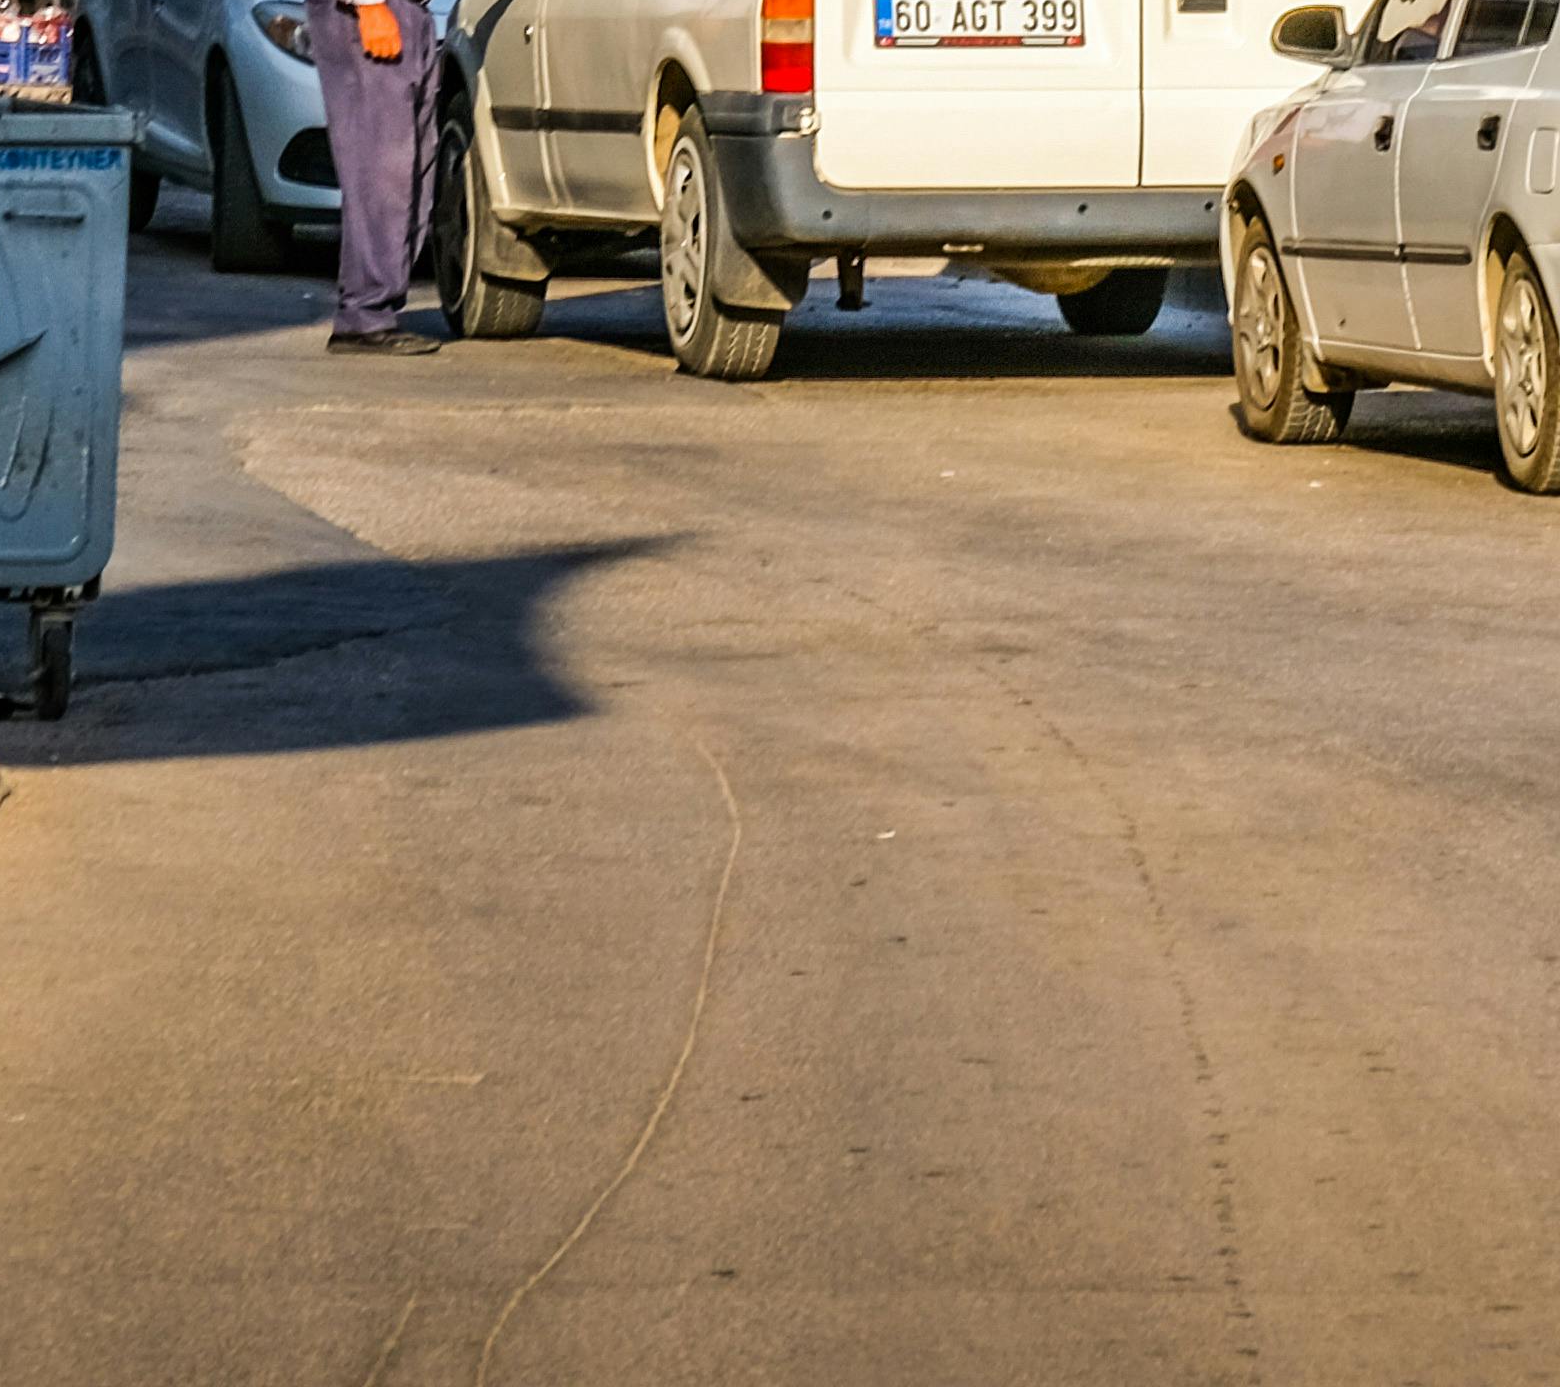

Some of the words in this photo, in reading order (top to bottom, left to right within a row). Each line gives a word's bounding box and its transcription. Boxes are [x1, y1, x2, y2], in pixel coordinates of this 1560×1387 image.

[895, 0, 931, 33] 60
[951, 0, 1007, 33] AGT
[1022, 0, 1078, 34] 399
